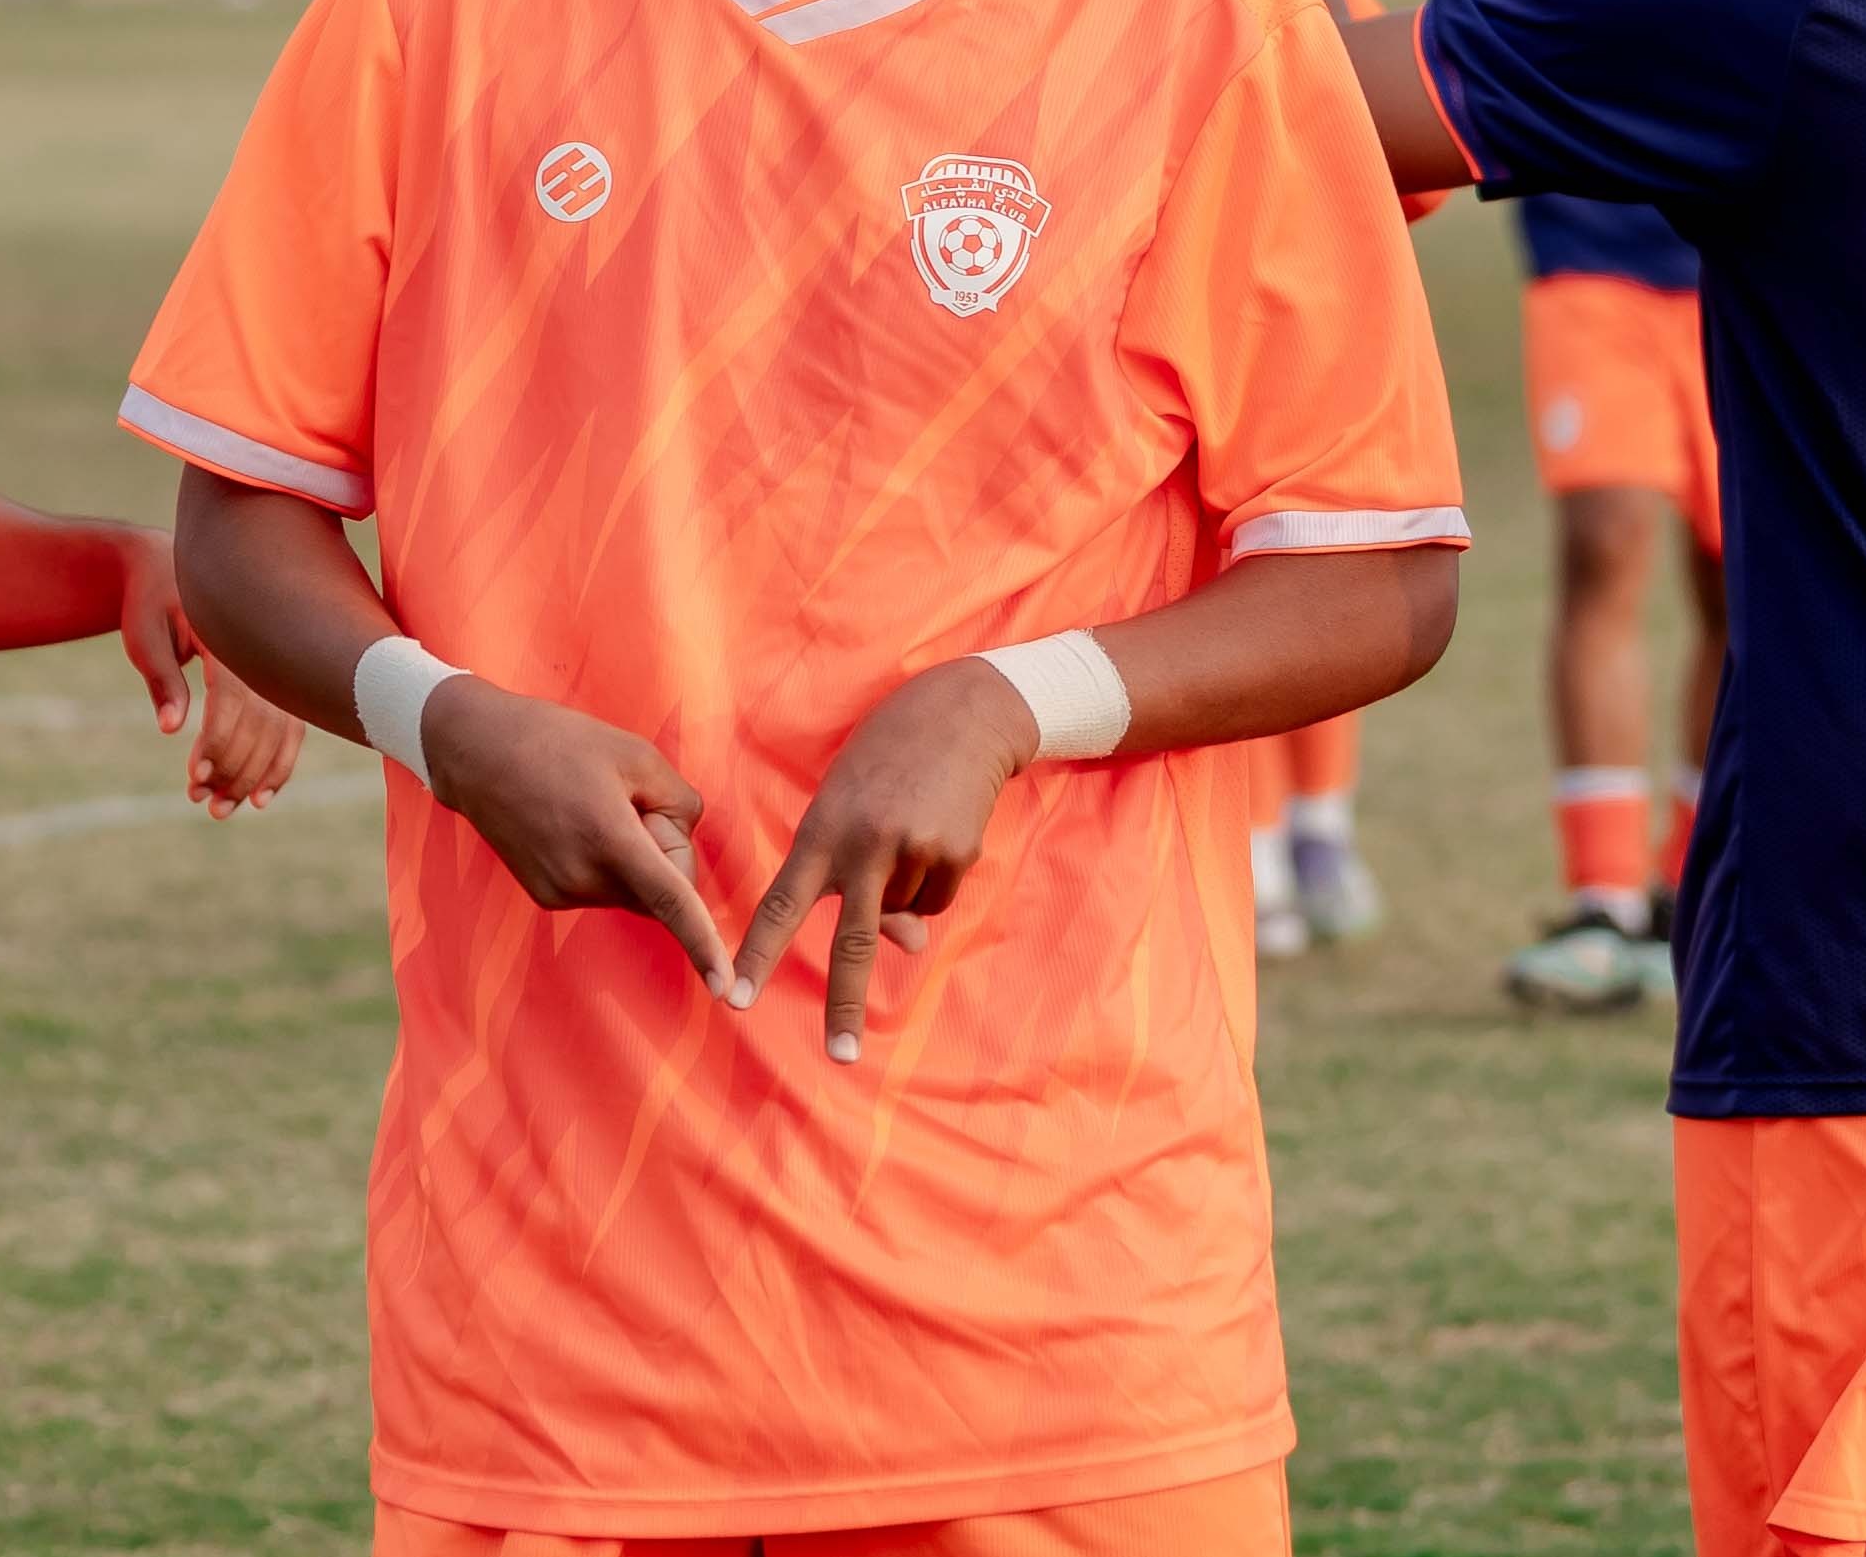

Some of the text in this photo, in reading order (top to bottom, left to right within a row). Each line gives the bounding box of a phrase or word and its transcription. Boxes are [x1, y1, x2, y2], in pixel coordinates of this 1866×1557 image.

[922, 196, 1027, 223] ALFAYHA CLUB
[995, 186, 1037, 210] نادي
[954, 291, 979, 304] 1953
